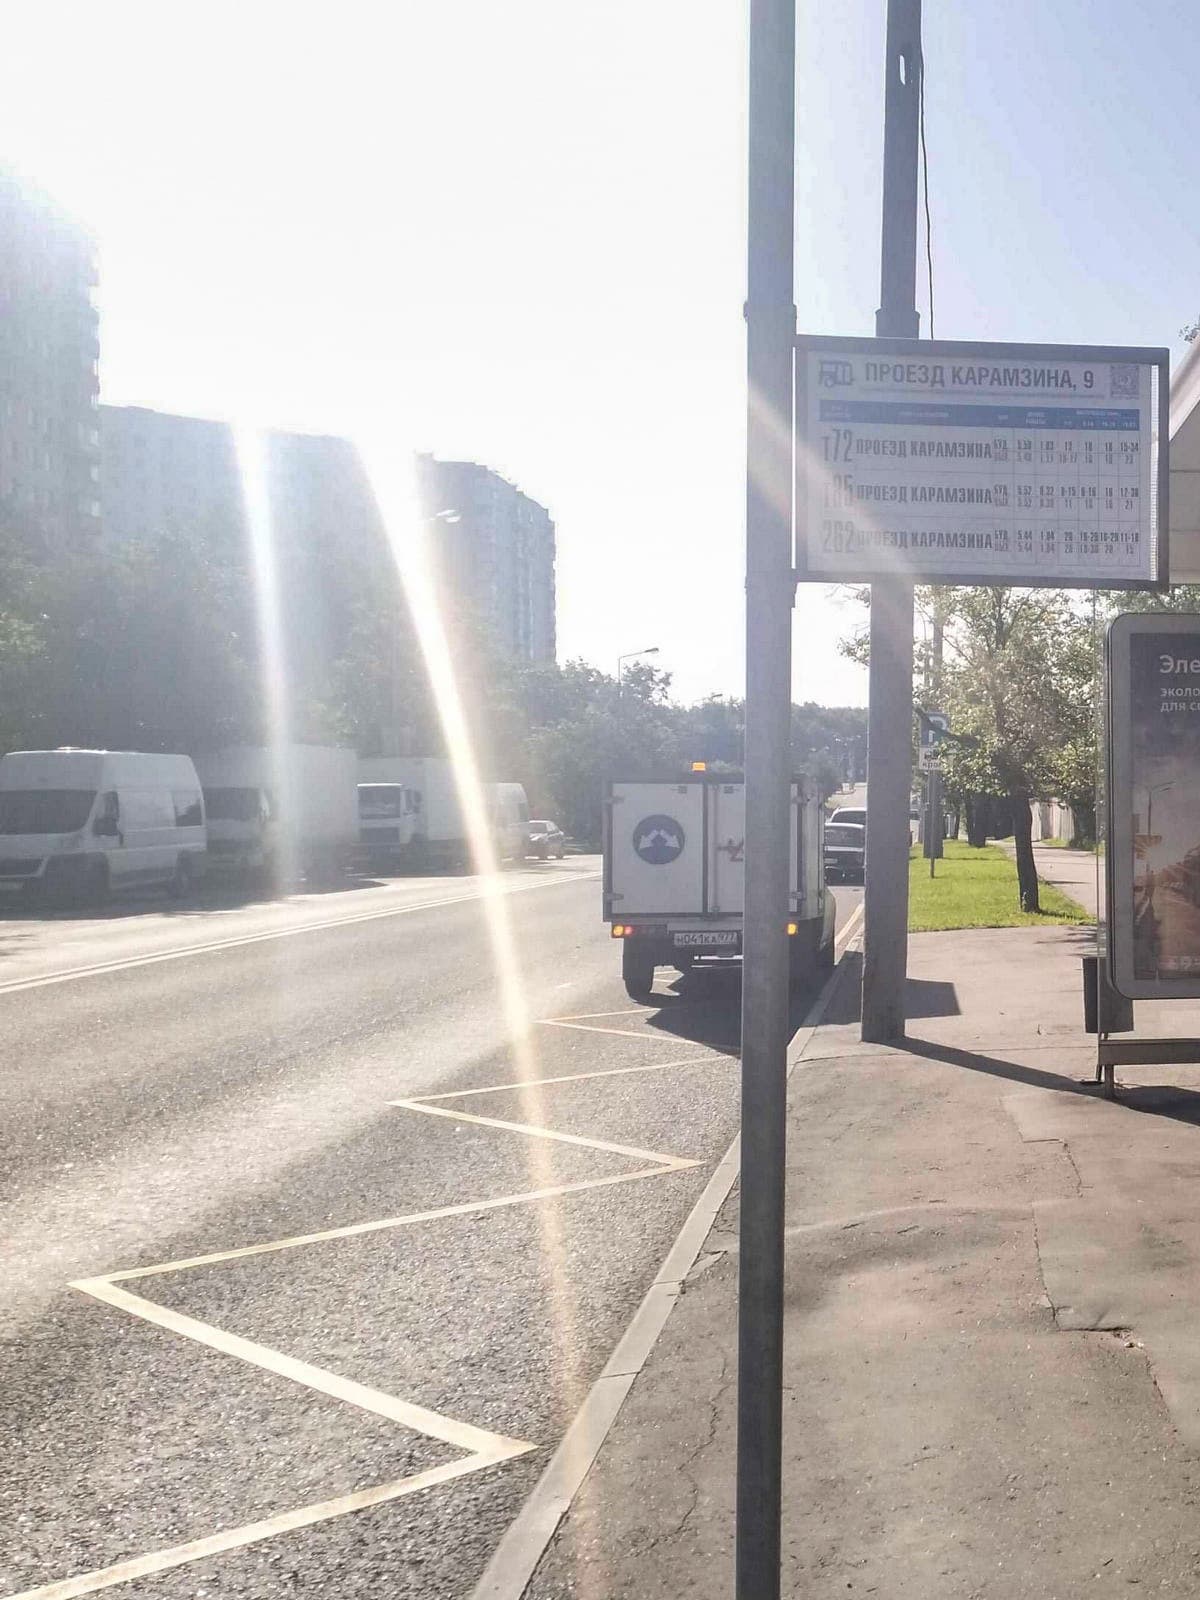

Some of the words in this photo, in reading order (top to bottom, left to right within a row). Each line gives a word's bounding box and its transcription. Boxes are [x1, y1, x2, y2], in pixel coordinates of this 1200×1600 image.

[865, 362, 945, 388] ПРОЕЗД
[951, 365, 1077, 391] КАРАМЗИНА,
[1083, 369, 1095, 389] 9
[856, 438, 907, 458] ПРОЕЗД
[910, 440, 992, 459] КАРАМЗИНА
[856, 484, 908, 504] ПРОЕЗД
[911, 486, 993, 504] КАРАМЗИНА
[911, 531, 993, 549] КАРАМЗИНА
[1160, 700, 1187, 713] для
